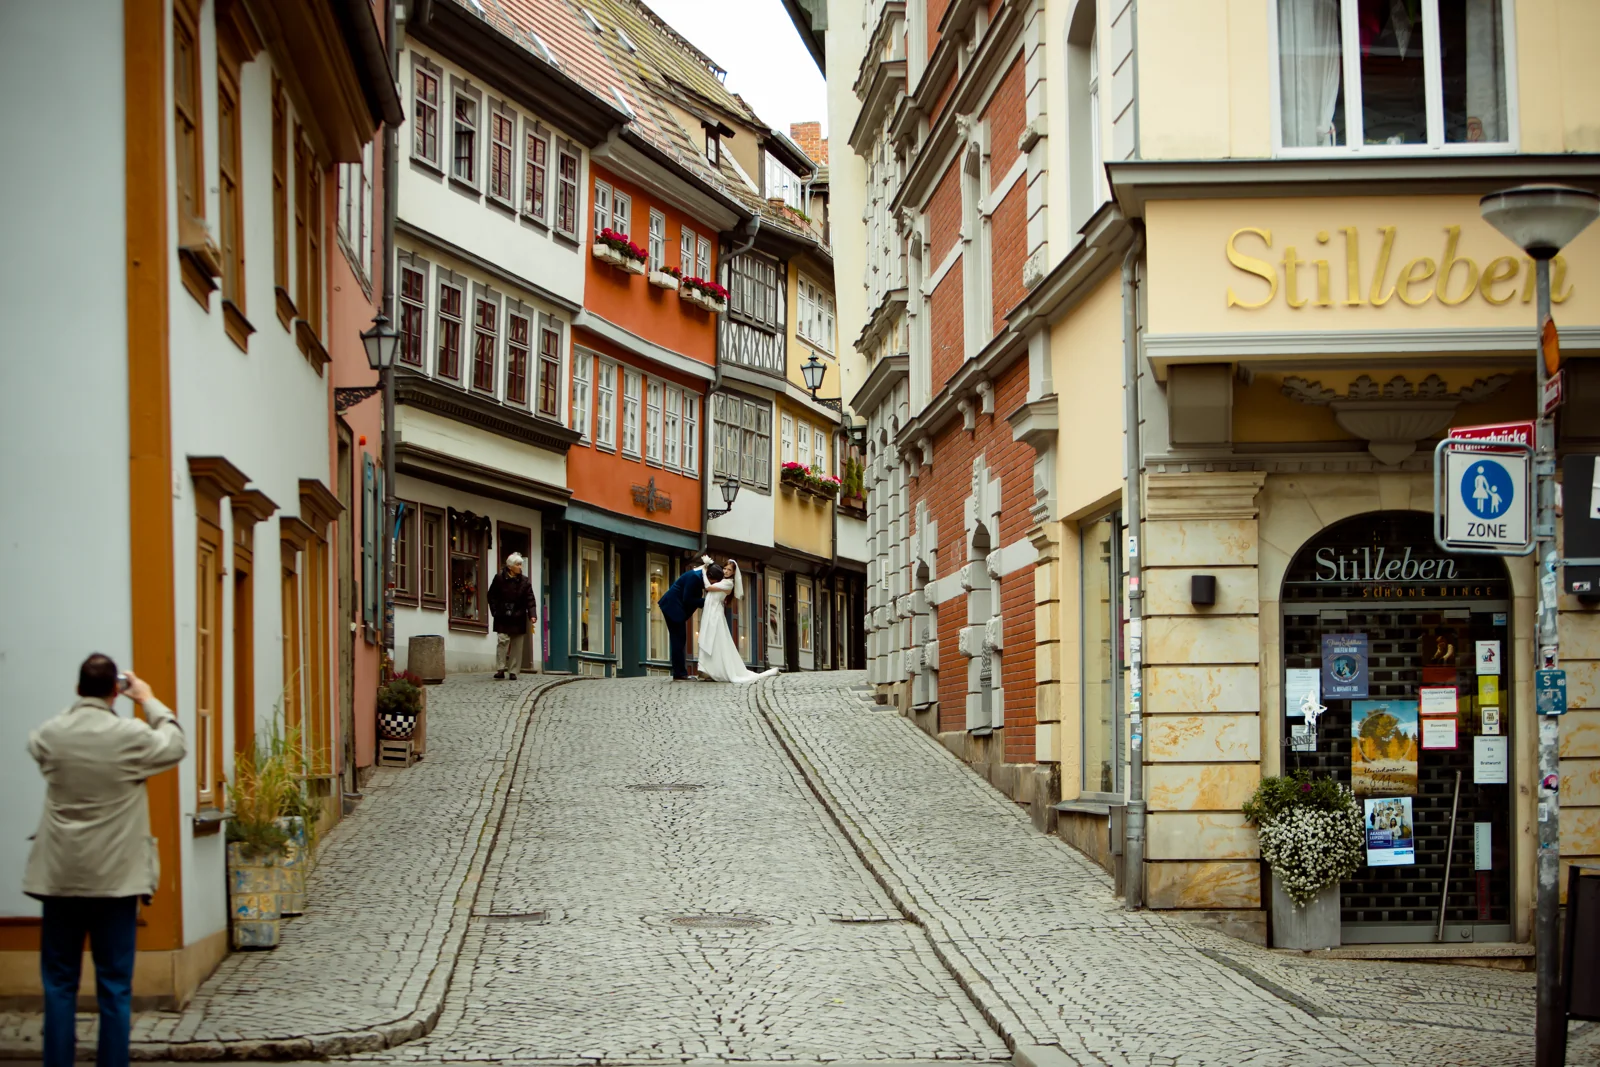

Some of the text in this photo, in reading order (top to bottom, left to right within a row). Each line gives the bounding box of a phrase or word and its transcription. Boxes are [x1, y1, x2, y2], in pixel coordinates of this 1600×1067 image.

[1226, 225, 1574, 309] Stilleben
[1467, 523, 1507, 538] ZONE
[1315, 546, 1458, 581] Stilleben
[1440, 586, 1492, 597] DINGE
[1543, 675, 1551, 686] S
